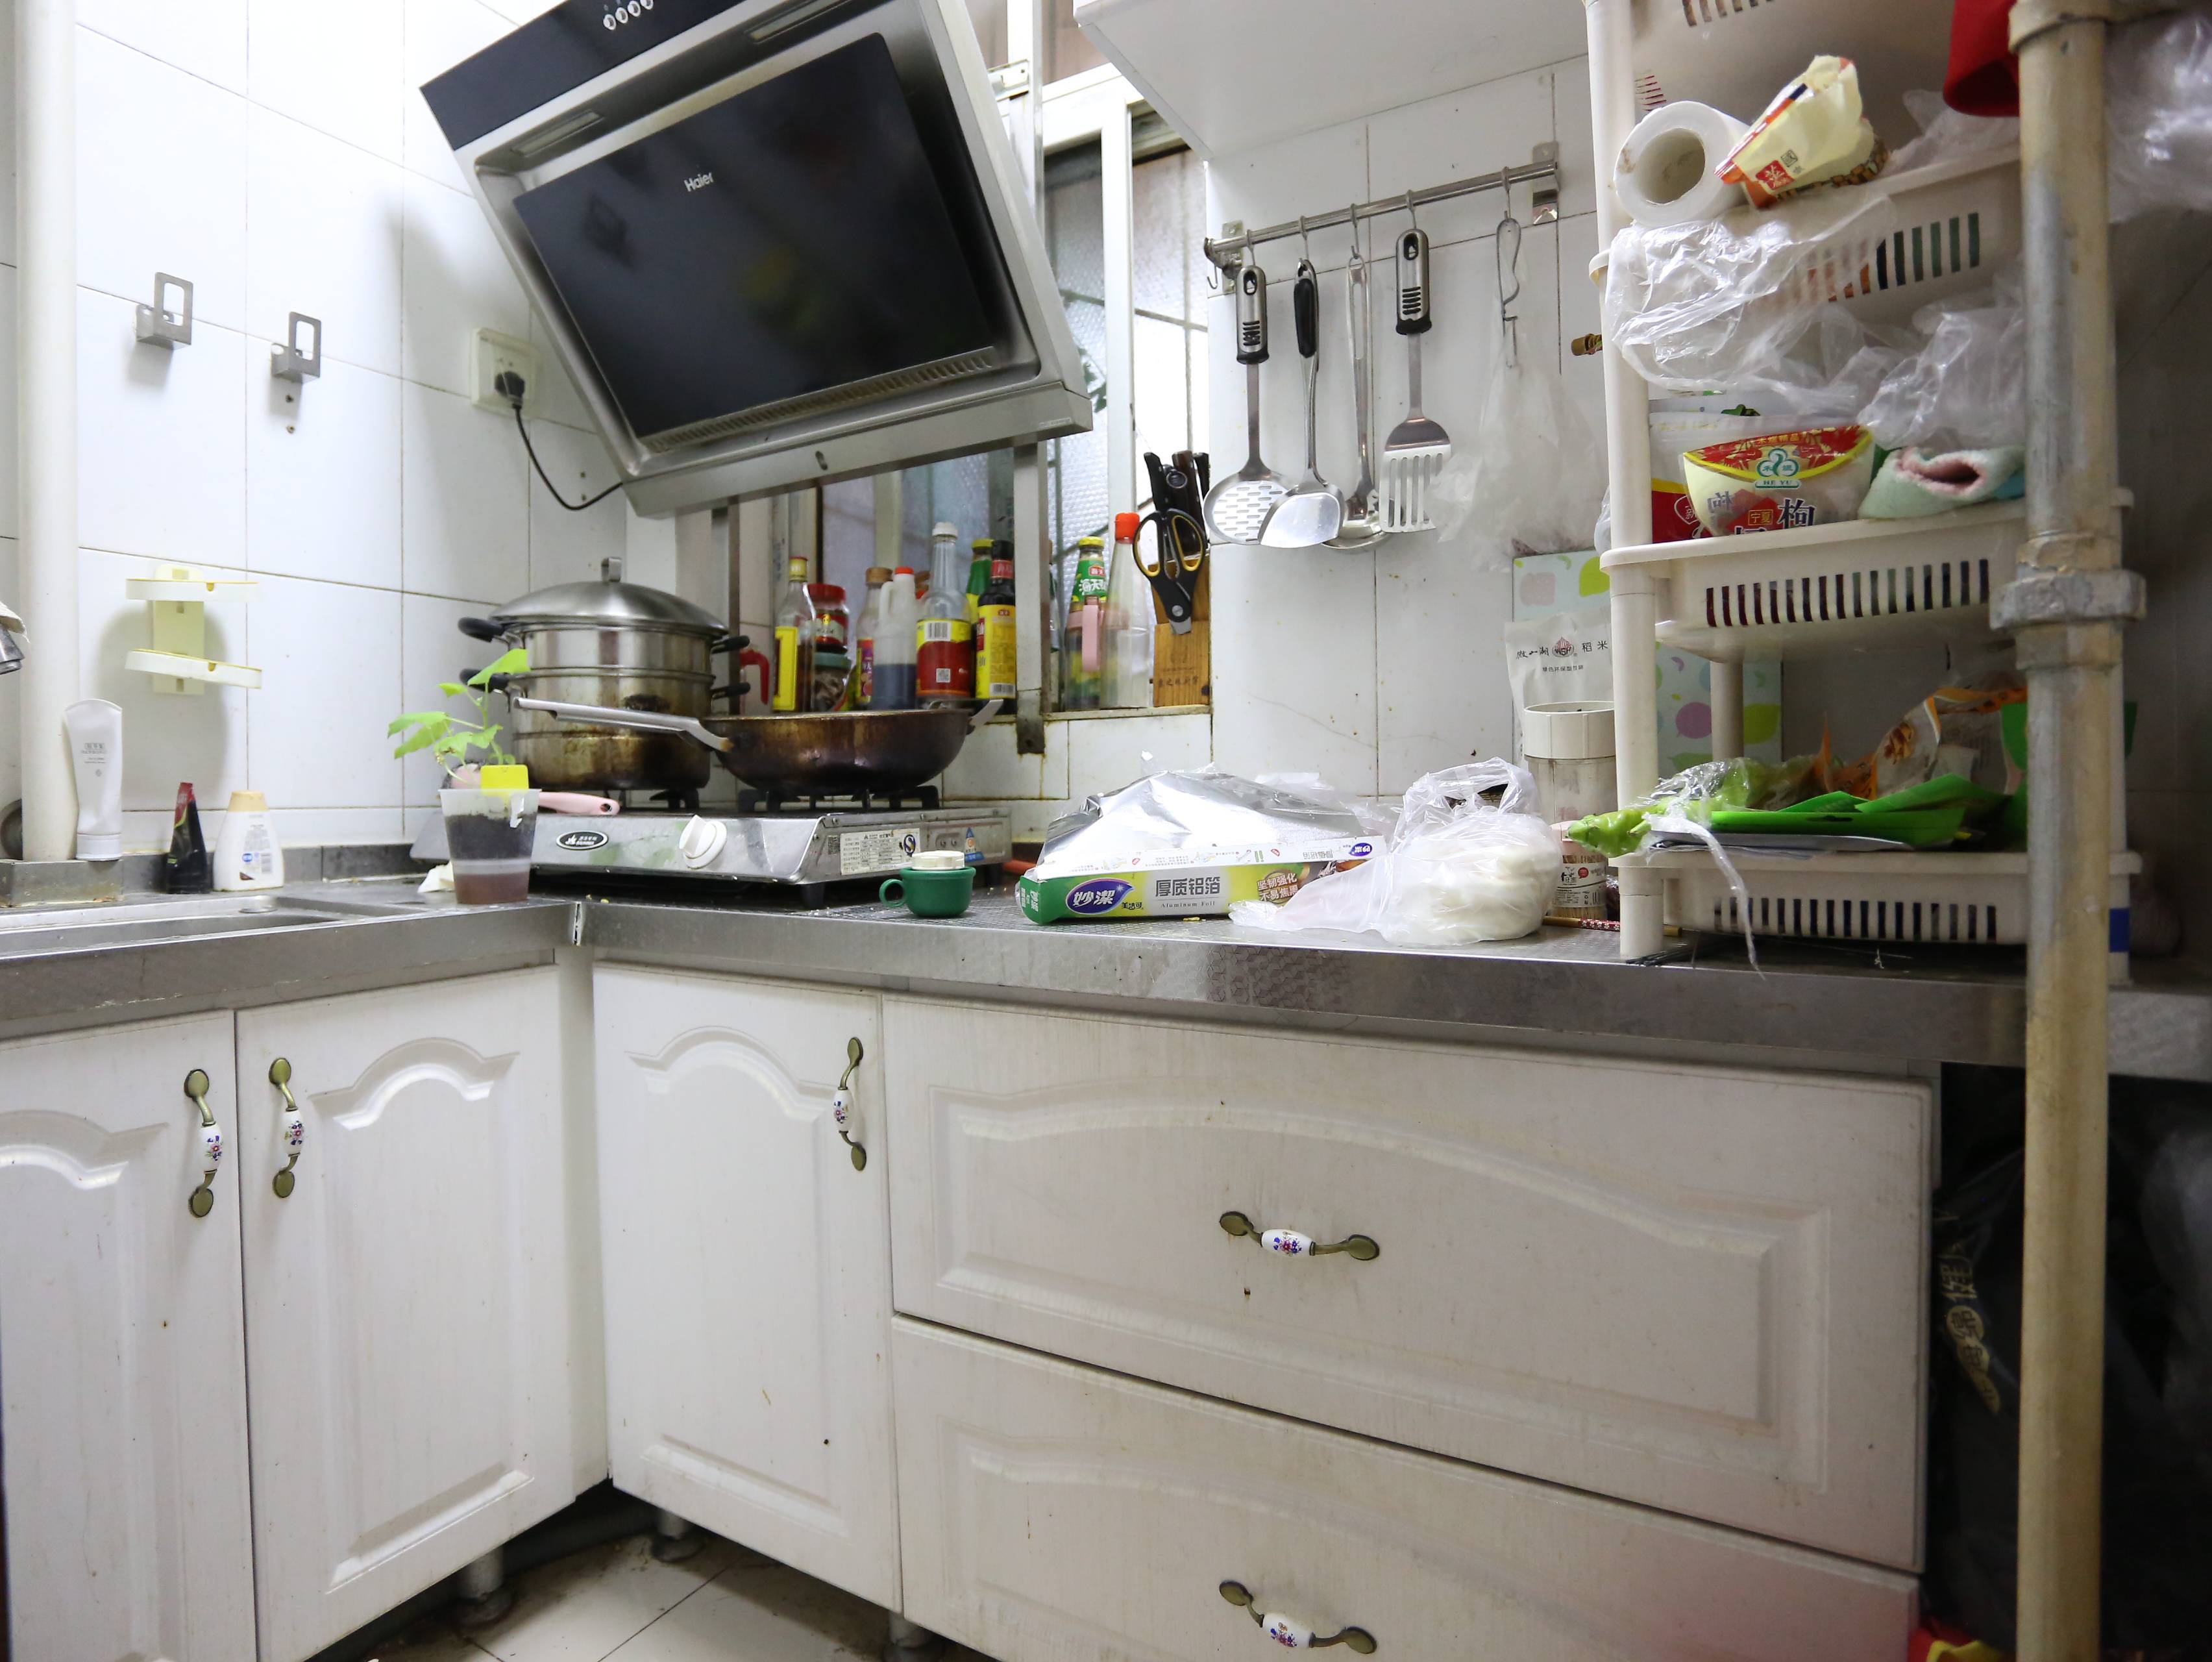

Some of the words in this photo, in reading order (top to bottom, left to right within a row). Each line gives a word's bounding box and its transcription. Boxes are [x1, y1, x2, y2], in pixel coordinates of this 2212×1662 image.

[684, 172, 714, 192] Haier
[1750, 510, 1773, 524] 宁夏
[1581, 639, 1608, 653] 稻米
[1155, 876, 1221, 897] 厚质铝箔
[1257, 873, 1298, 891] 坚韧强化
[1072, 889, 1116, 907] 妙潔
[1259, 884, 1298, 901] 不易焦黑
